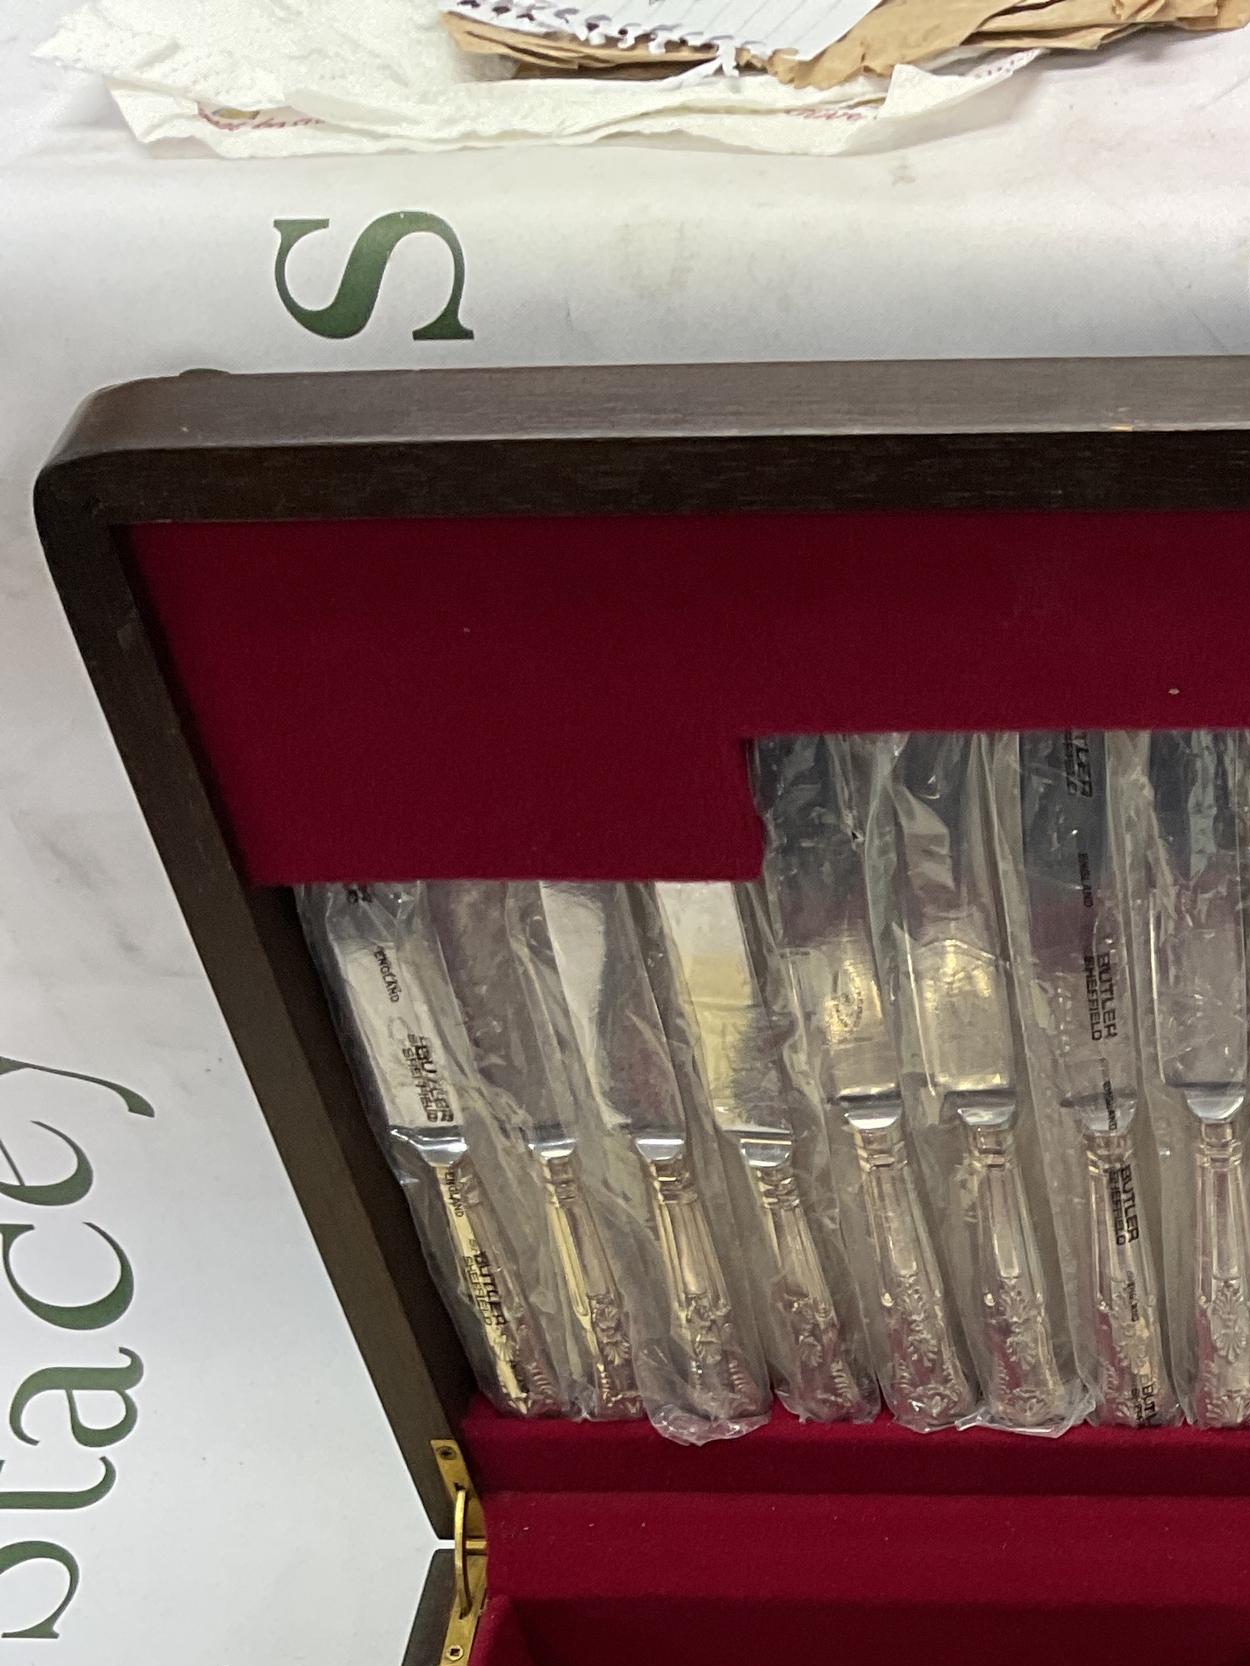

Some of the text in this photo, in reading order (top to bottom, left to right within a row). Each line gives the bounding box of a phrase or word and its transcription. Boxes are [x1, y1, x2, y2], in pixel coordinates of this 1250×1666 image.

[374, 947, 401, 1003] ENGLAND
[445, 1170, 464, 1217] ENGLAND
[1120, 1164, 1140, 1242] BUTLER
